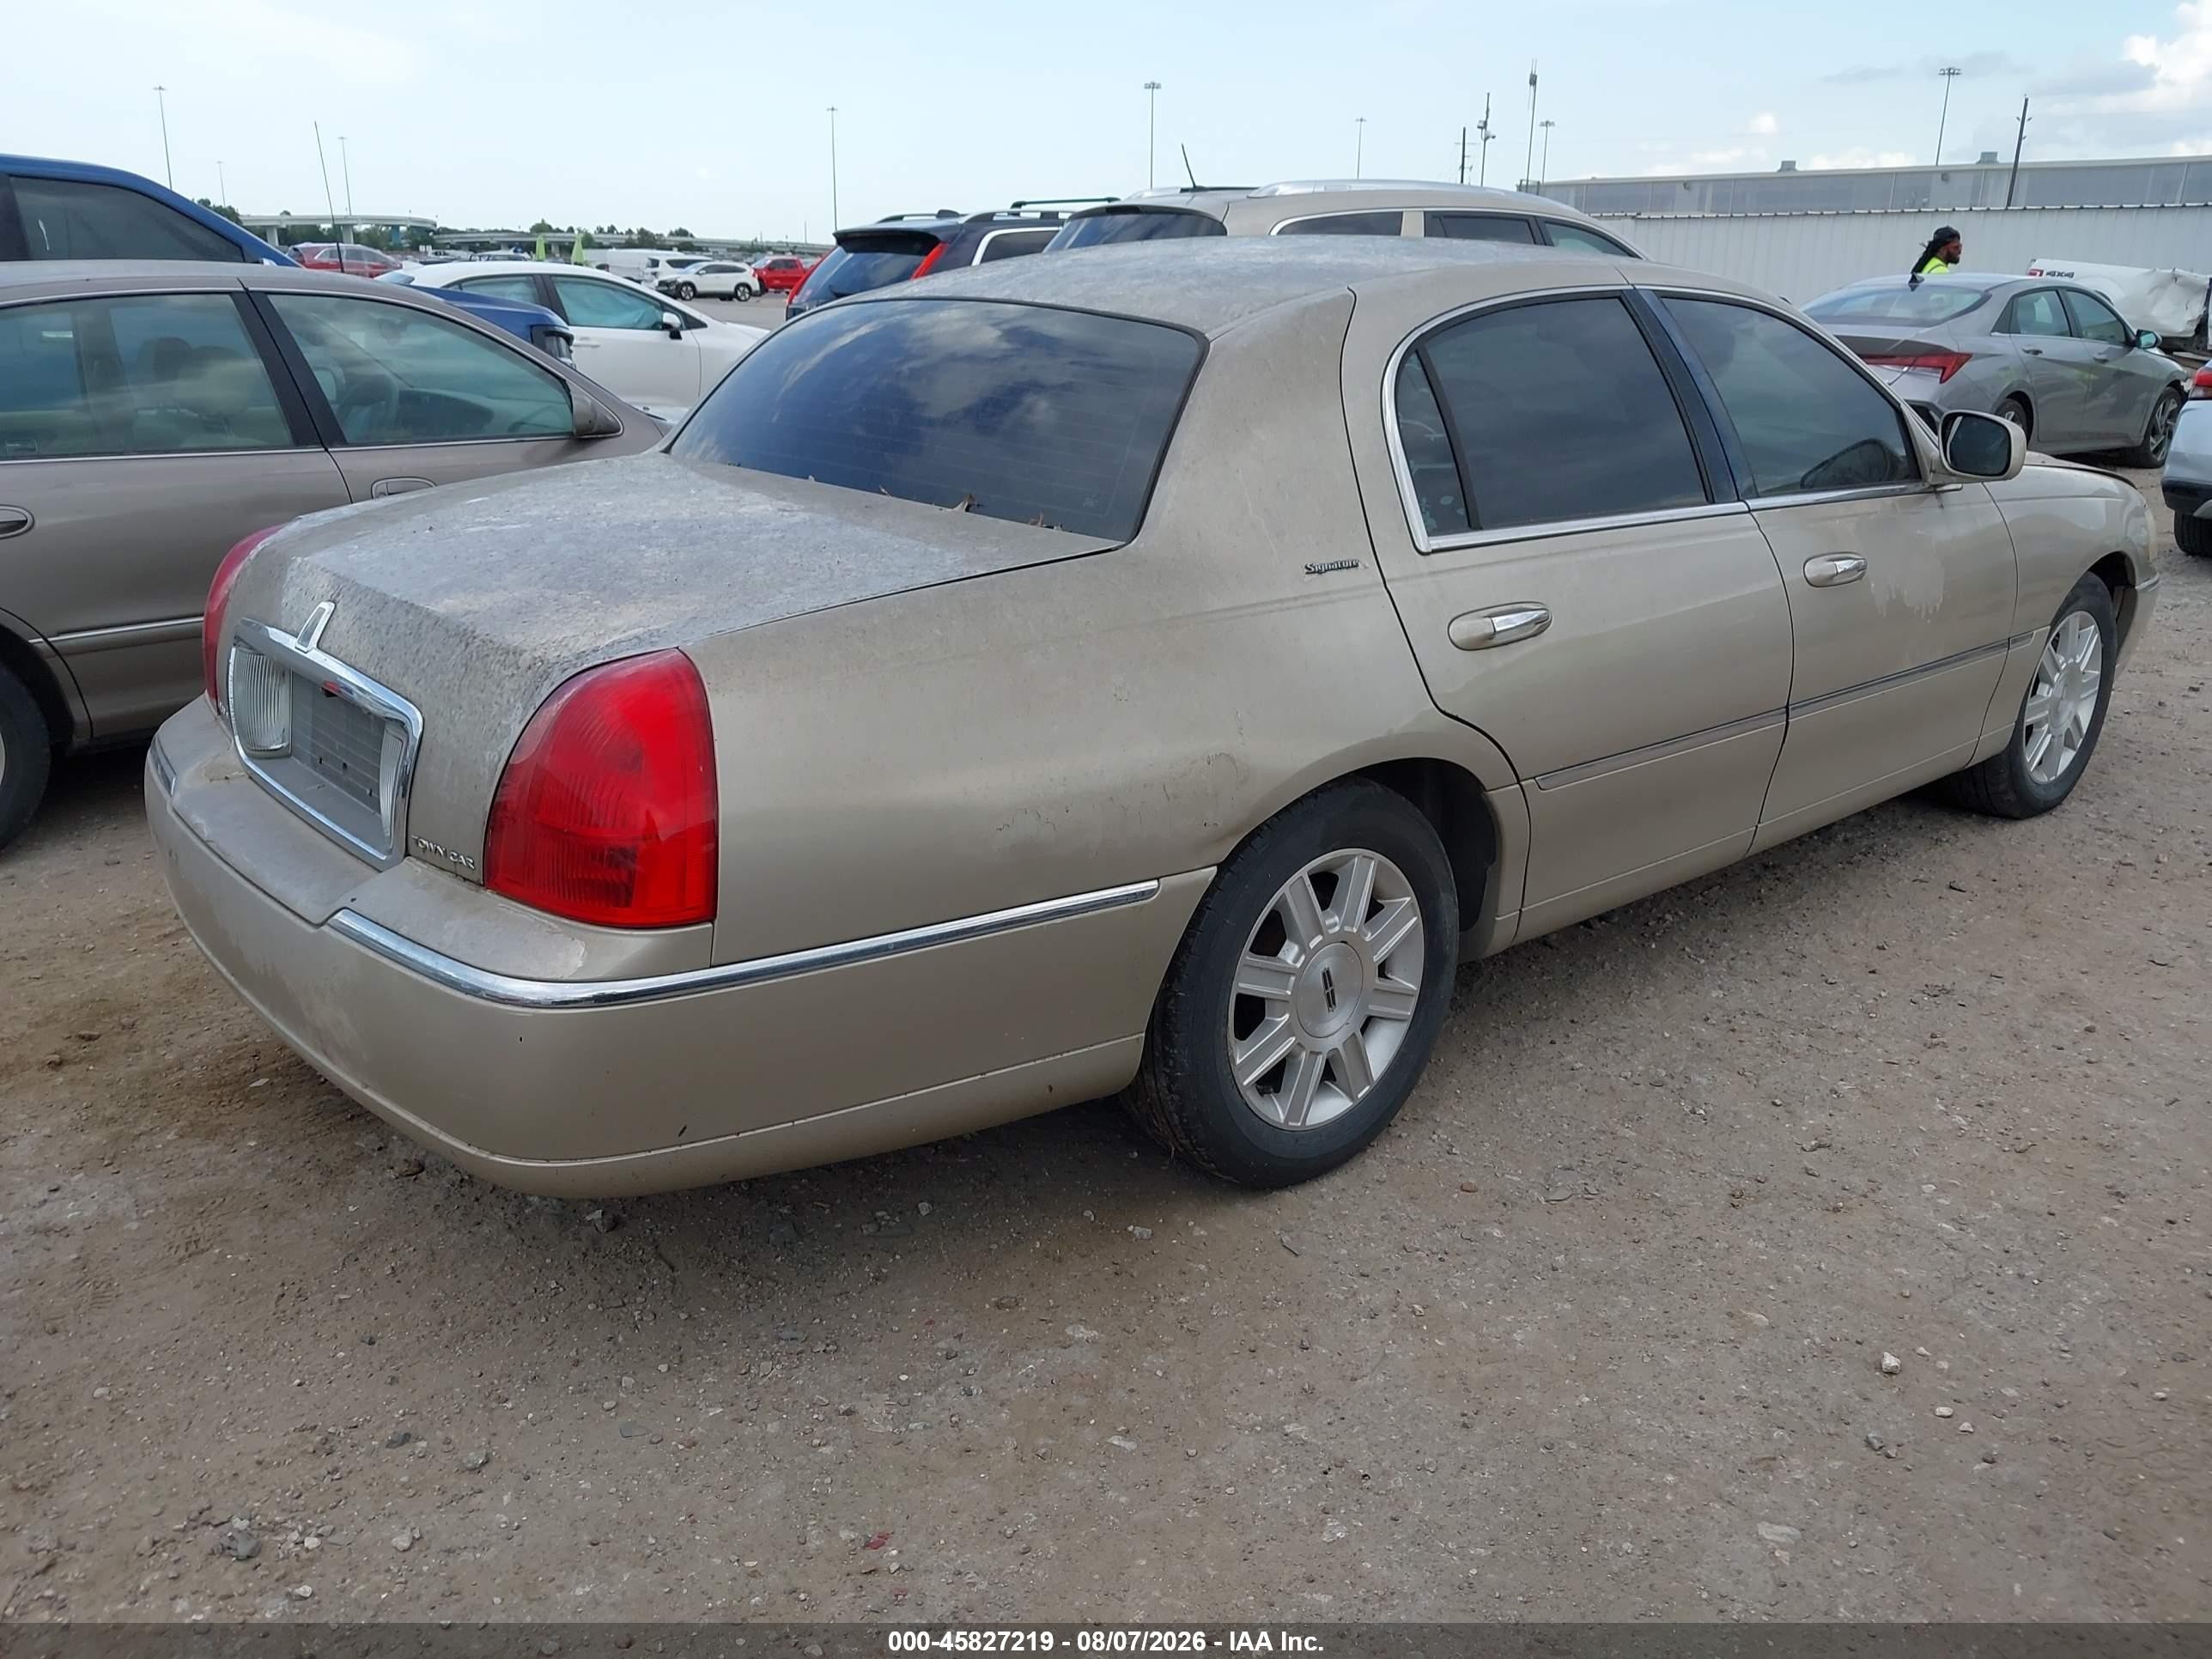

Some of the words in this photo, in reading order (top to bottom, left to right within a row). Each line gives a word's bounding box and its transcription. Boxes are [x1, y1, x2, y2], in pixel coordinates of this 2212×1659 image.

[1304, 558, 1359, 575] Signature
[411, 834, 447, 857] TOWN
[449, 851, 476, 870] CAR
